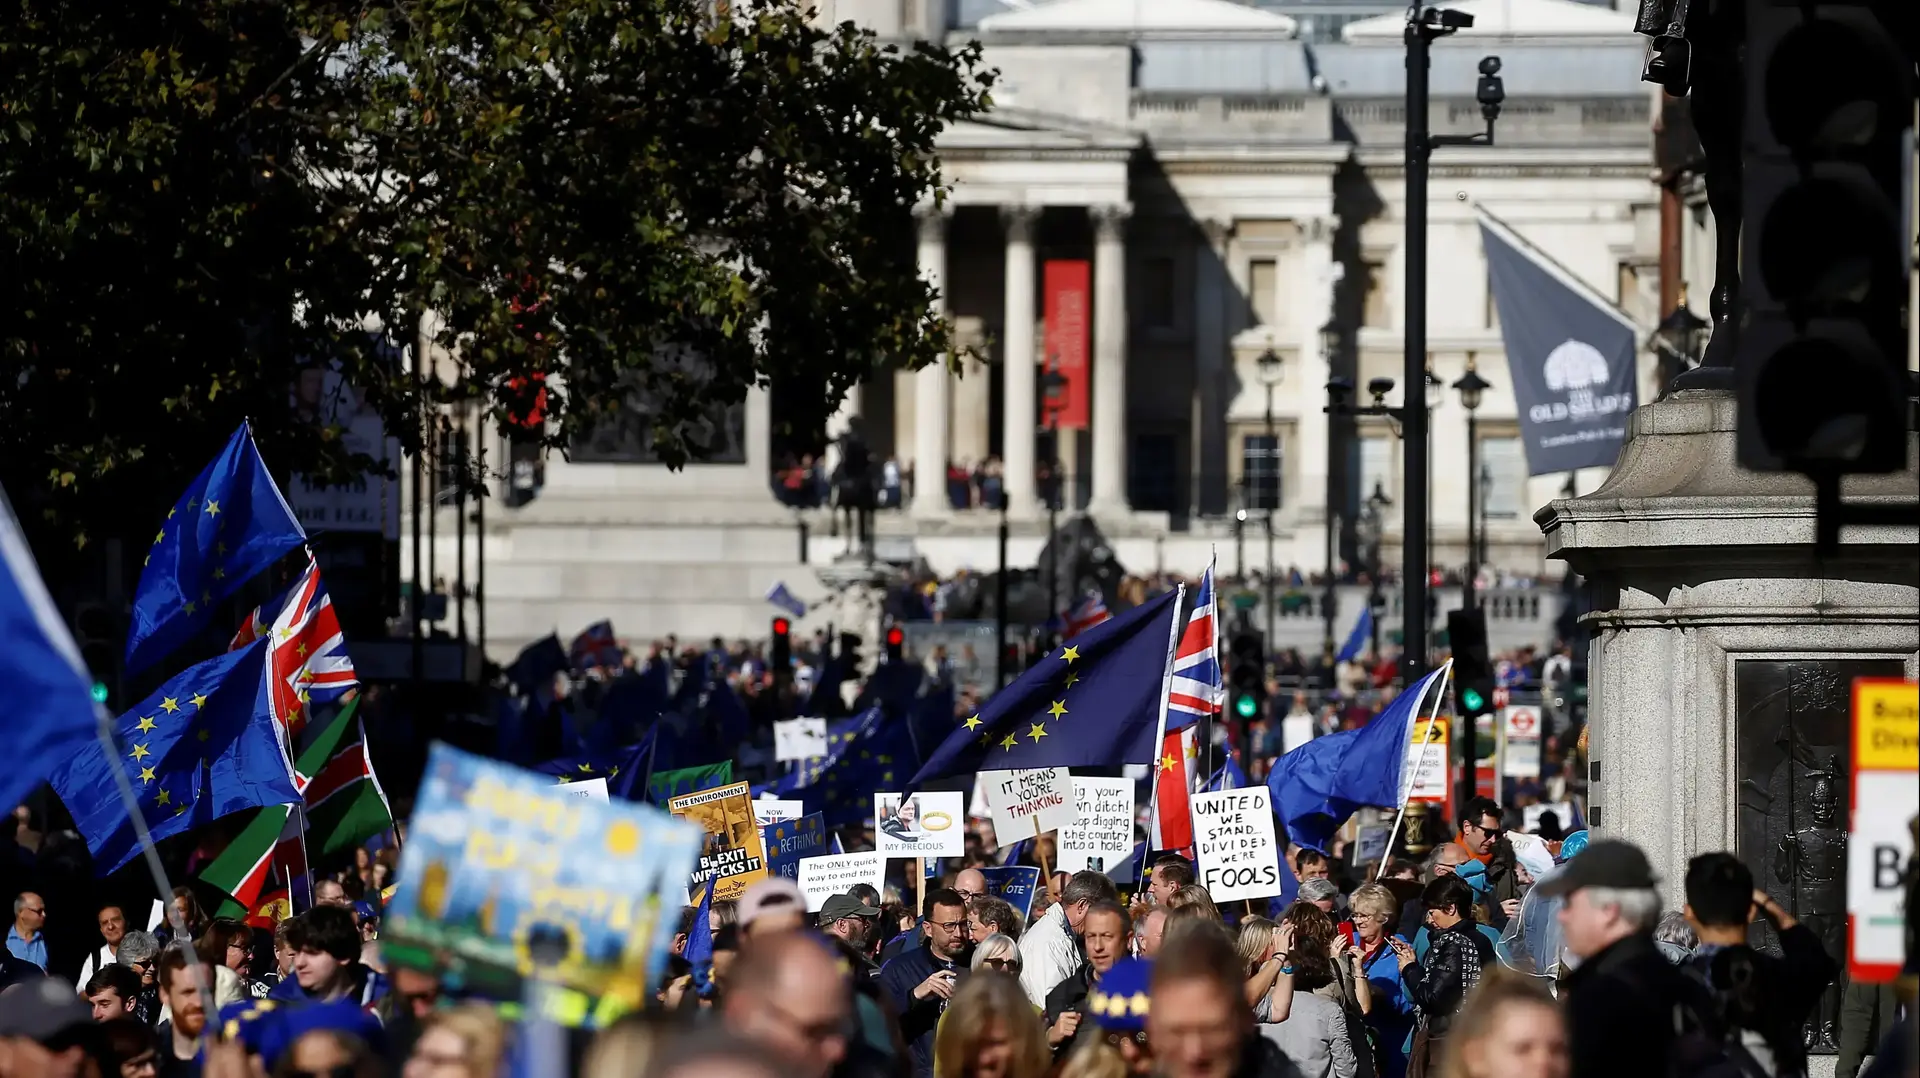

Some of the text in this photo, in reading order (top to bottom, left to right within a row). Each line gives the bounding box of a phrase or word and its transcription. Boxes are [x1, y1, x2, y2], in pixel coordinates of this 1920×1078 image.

[1529, 402, 1568, 423] OLD
[1001, 781, 1013, 795] IT
[1019, 767, 1056, 790] MEANS
[675, 786, 744, 808] THE ENVIRONMENT
[1016, 781, 1053, 801] YOU'RE
[1074, 783, 1124, 801] ig your
[1007, 792, 1063, 819] THINKING
[1076, 800, 1129, 814] wn ditch!
[1196, 795, 1264, 815] UNITED
[1092, 813, 1130, 832] digging
[1220, 813, 1243, 825] WE
[780, 830, 816, 853] RETHINK
[1064, 829, 1129, 842] the country
[885, 842, 944, 851] MY PRECIOUS
[1063, 840, 1127, 852] into a hole.
[1202, 838, 1267, 854] DIVIDED
[700, 848, 745, 868] BEXIT
[747, 857, 759, 871] IT
[809, 858, 878, 871] The ONLY quick
[1220, 851, 1256, 864] WE'RE
[781, 862, 798, 877] REV
[828, 872, 838, 880] to
[840, 869, 857, 878] end
[860, 869, 876, 877] this
[1874, 845, 1901, 891] B
[1206, 865, 1276, 894] FOOLS
[807, 885, 830, 894] mess
[833, 883, 840, 891] is
